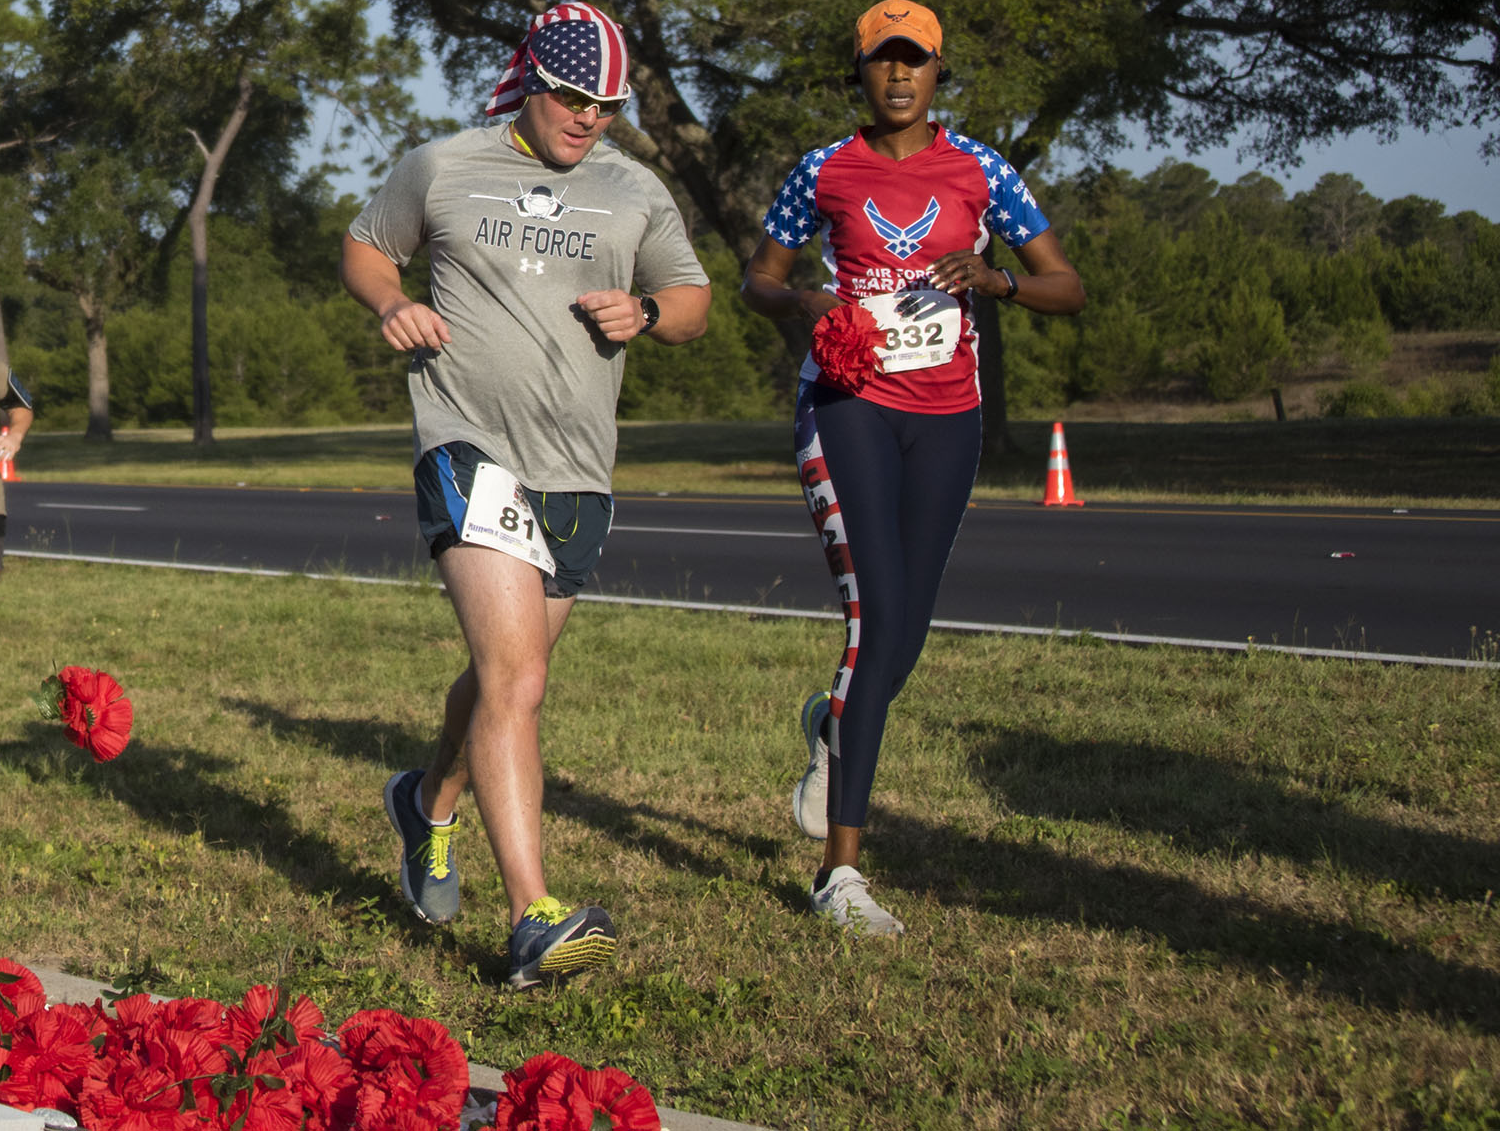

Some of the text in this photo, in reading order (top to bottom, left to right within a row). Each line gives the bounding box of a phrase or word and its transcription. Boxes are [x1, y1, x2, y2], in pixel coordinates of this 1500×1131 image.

[474, 216, 598, 261] AIR FORCE
[866, 268, 935, 281] AIR FORC
[886, 322, 944, 351] 332
[499, 506, 534, 542] 81
